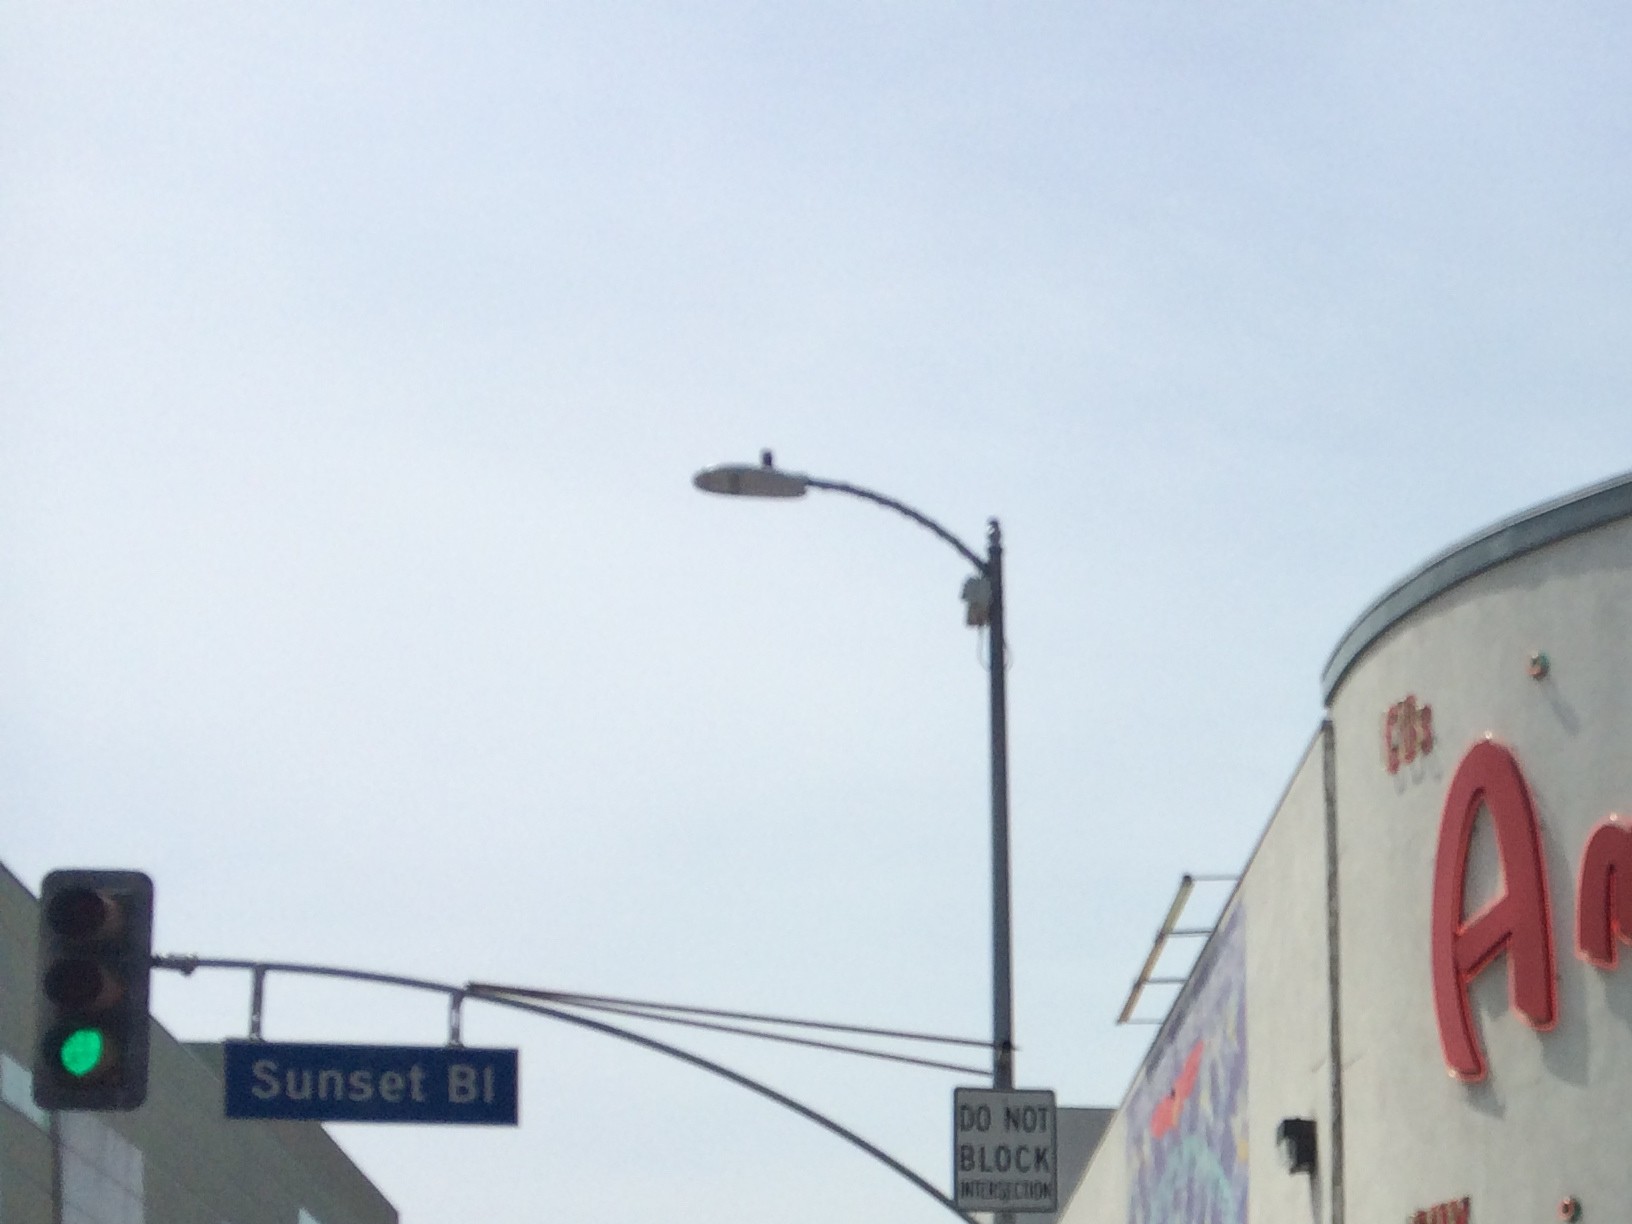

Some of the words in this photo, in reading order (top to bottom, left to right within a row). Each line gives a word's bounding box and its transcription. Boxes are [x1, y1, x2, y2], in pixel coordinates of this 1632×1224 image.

[251, 1059, 427, 1102] Sunset
[450, 1063, 496, 1104] Bl
[960, 1104, 992, 1132] DO
[1004, 1105, 1049, 1133] NOT
[960, 1144, 1050, 1173] BLOCK
[960, 1182, 1051, 1200] INTERSECTION
